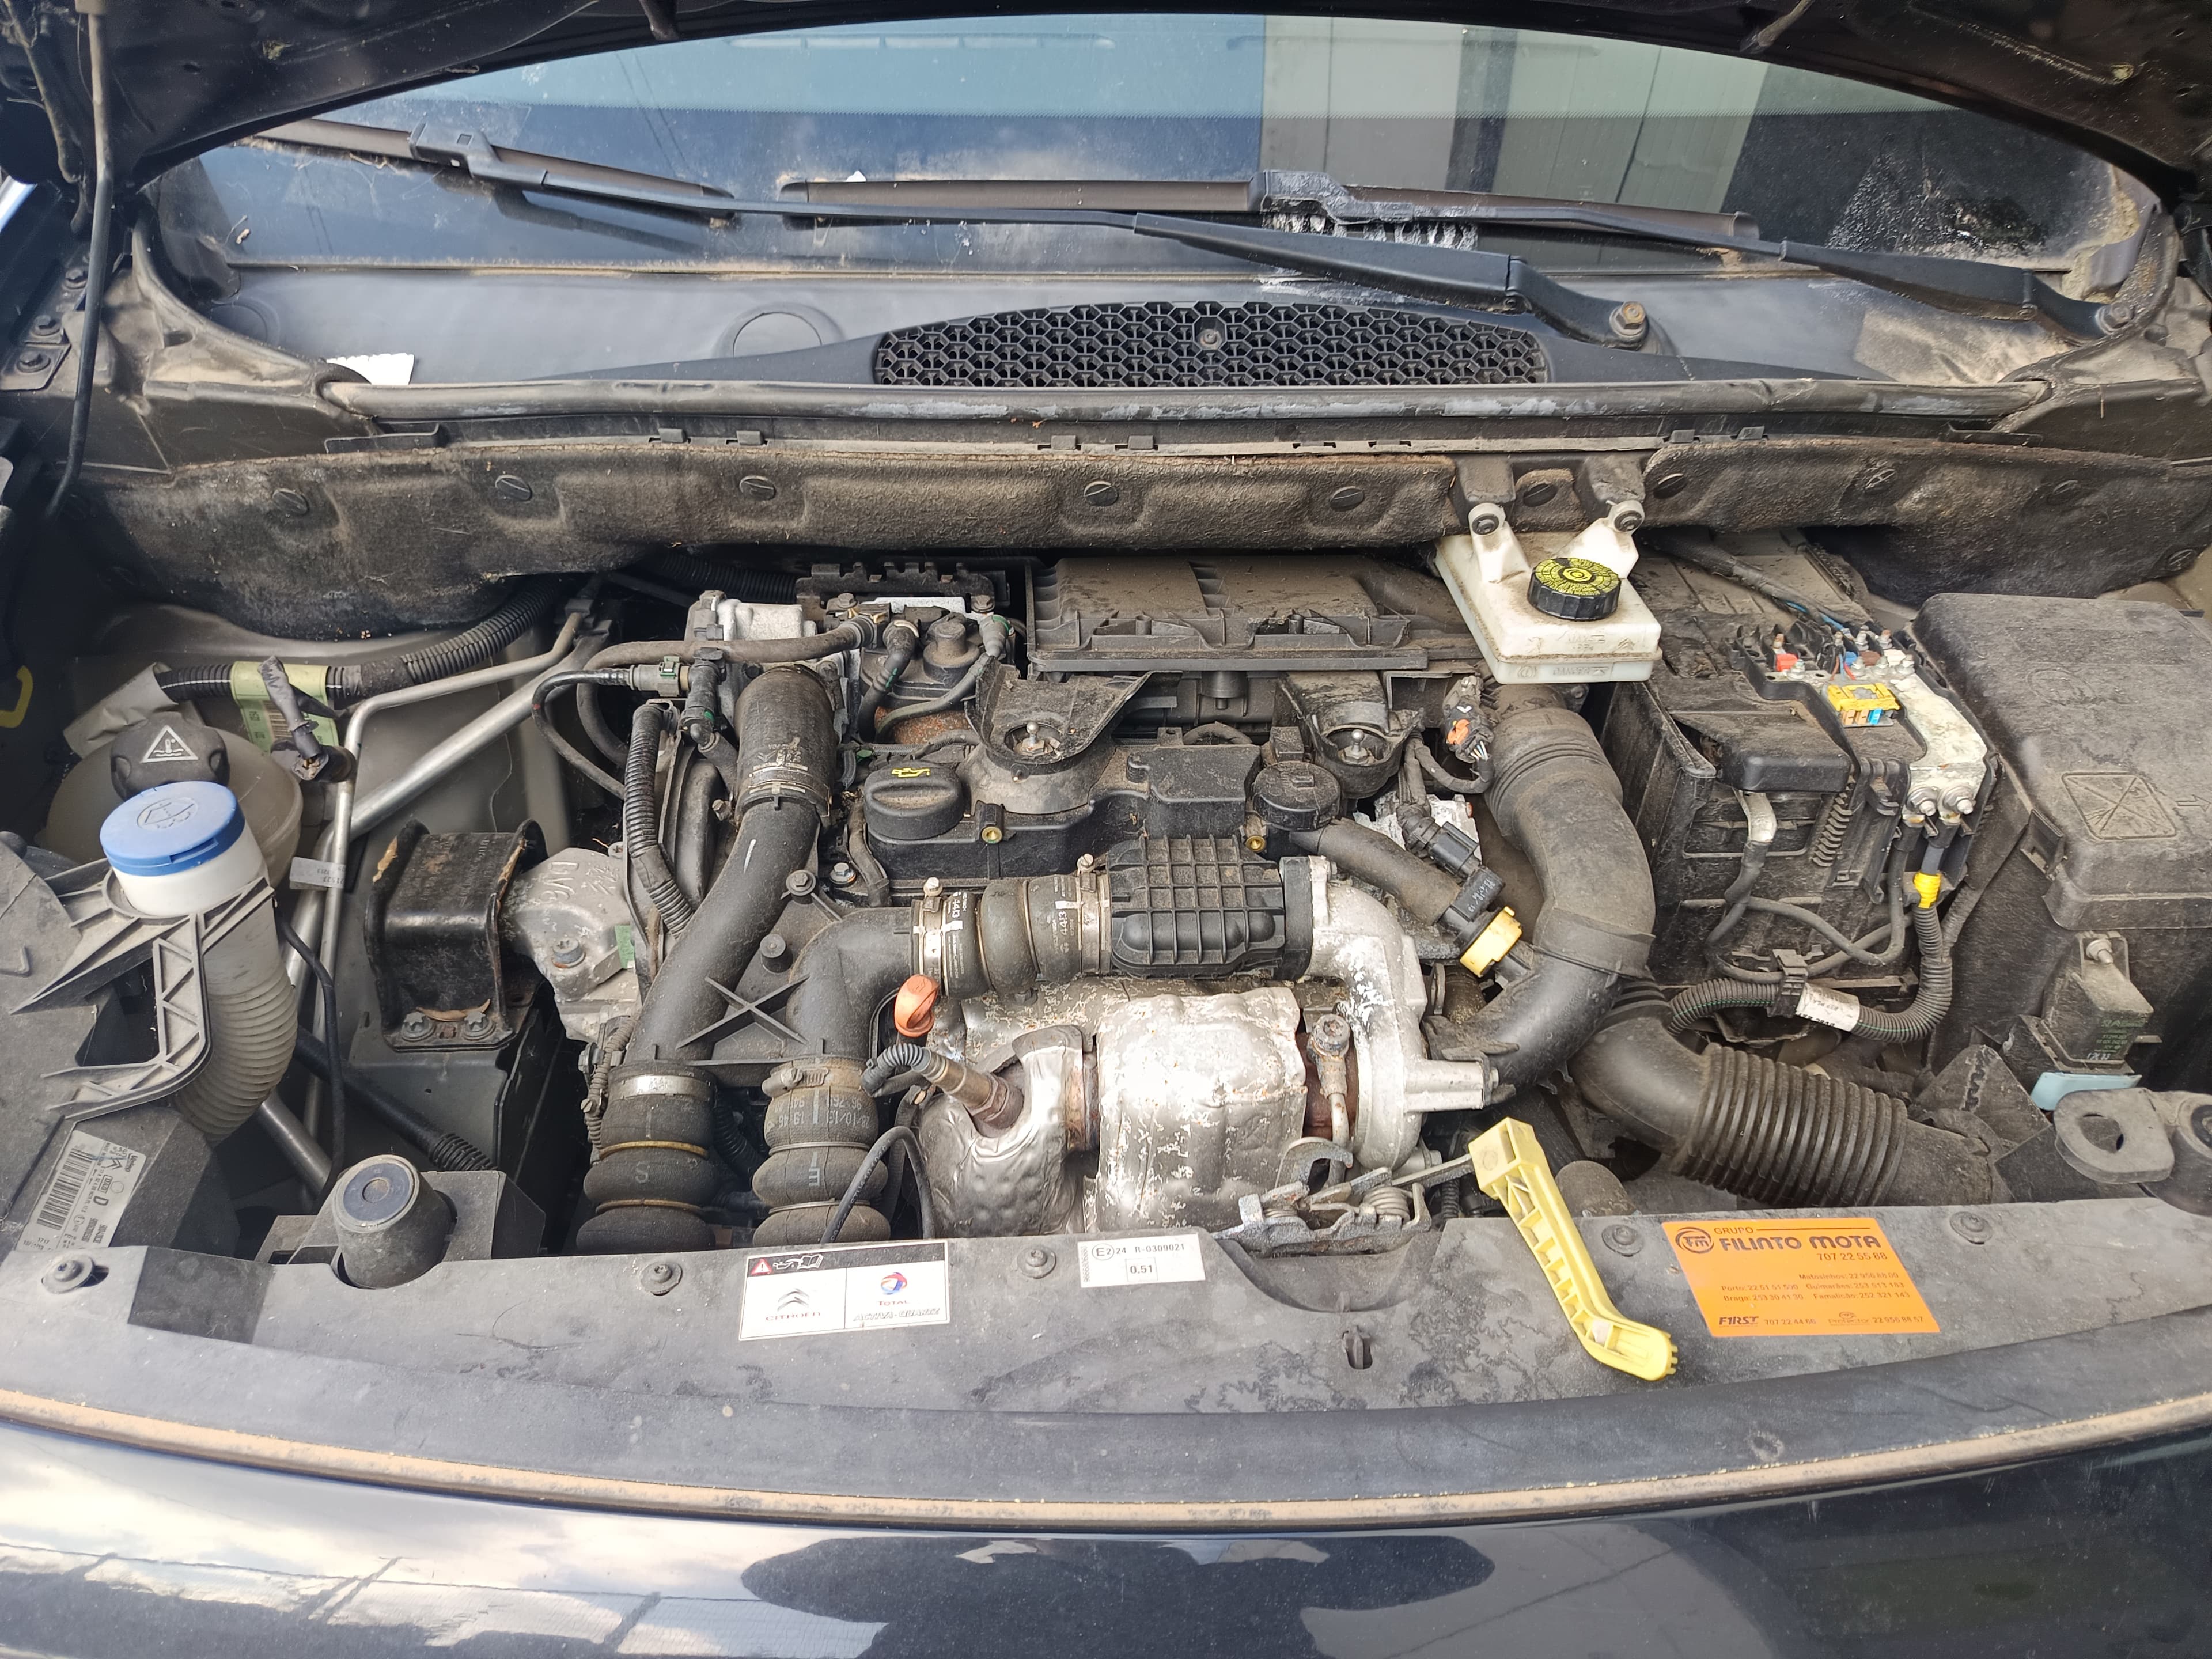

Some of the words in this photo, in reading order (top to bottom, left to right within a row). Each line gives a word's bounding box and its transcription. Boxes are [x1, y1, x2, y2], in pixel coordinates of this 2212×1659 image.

[1714, 1226, 1753, 1235] GRUPO
[1135, 1243, 1185, 1253] R-0309021
[1719, 1236, 1802, 1251] FILINTO
[1809, 1235, 1881, 1249] MOTA
[1816, 1253, 1836, 1261] 707
[1840, 1253, 1855, 1261] 22
[1857, 1252, 1871, 1260] 55
[1130, 1264, 1153, 1274] 0.51
